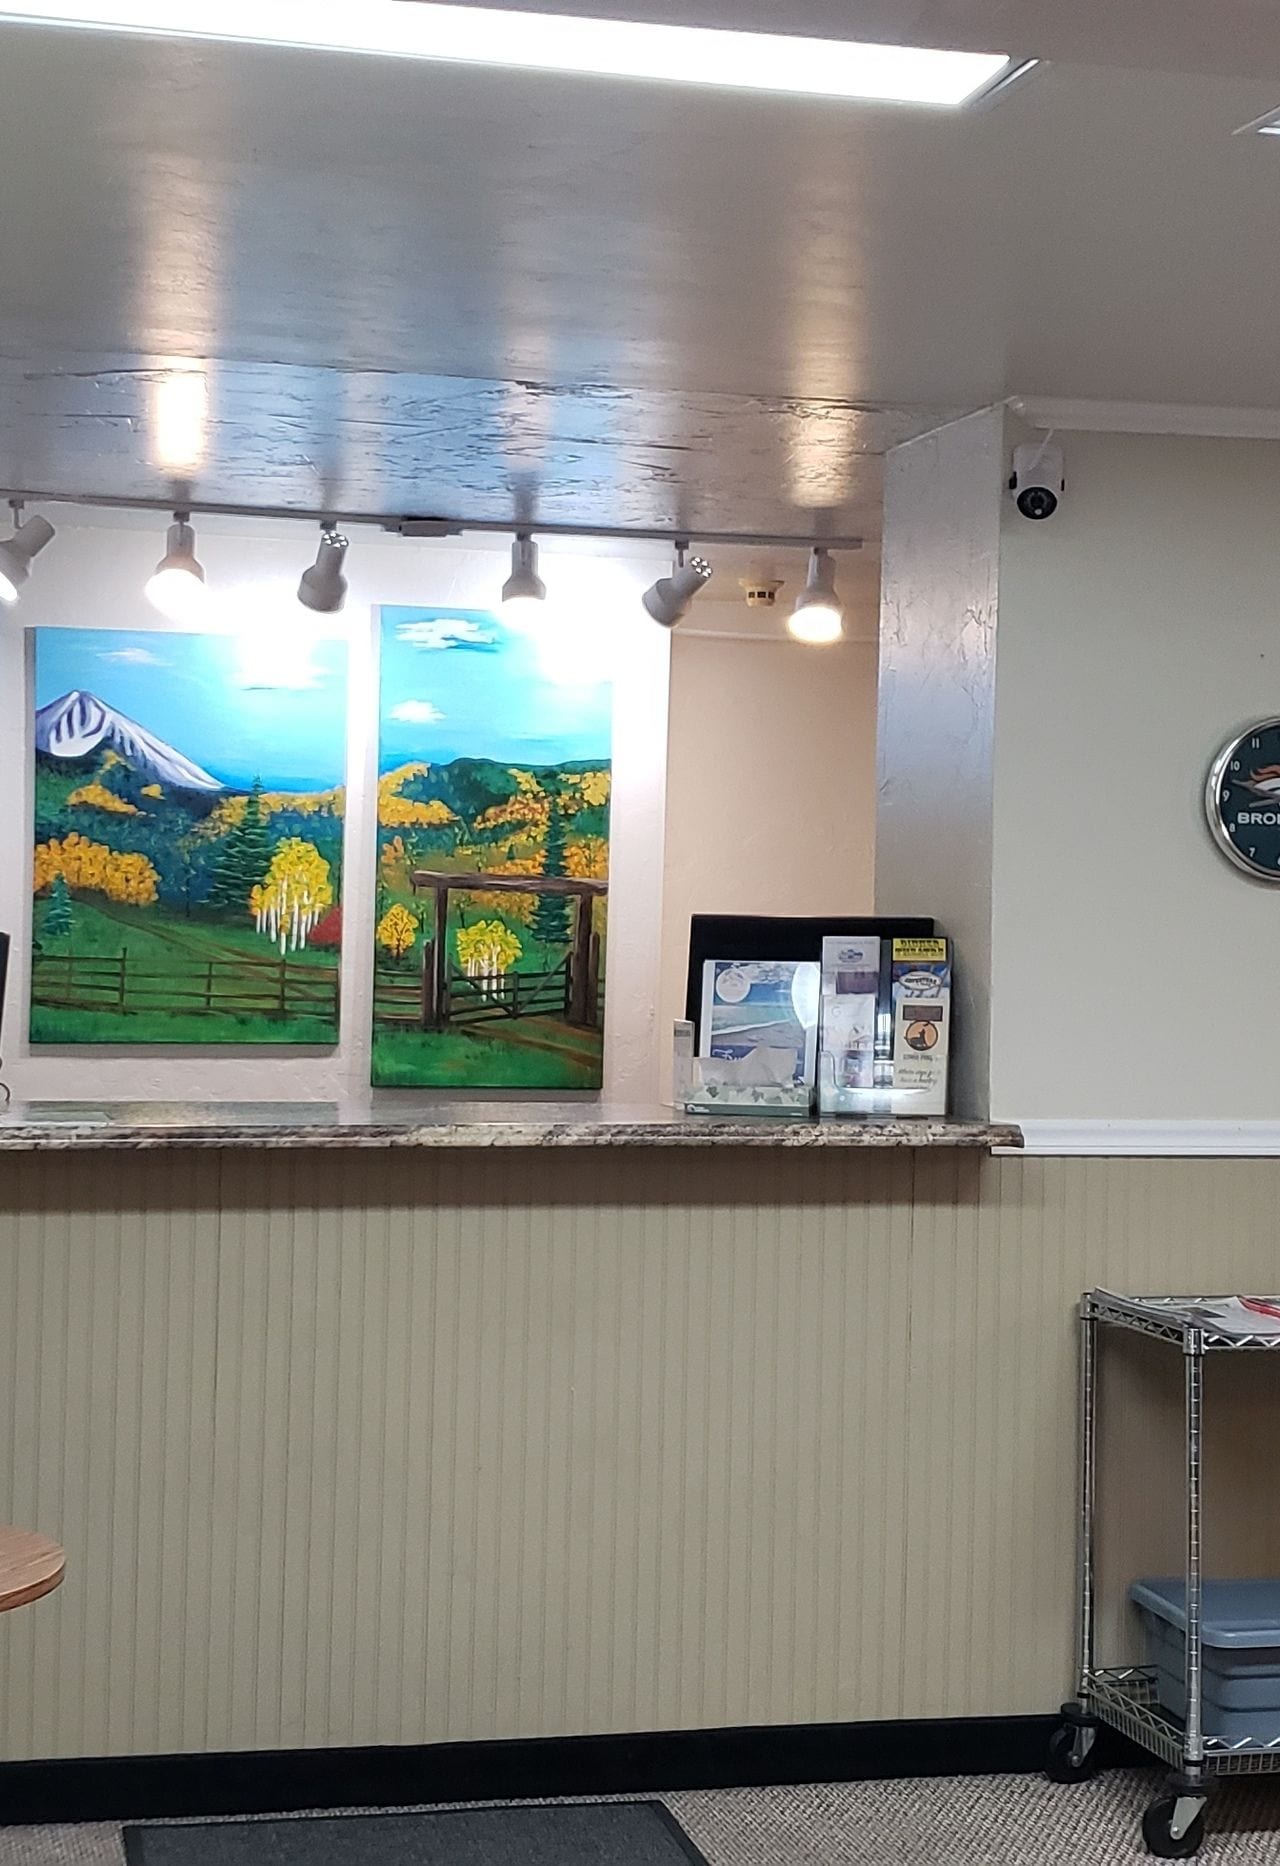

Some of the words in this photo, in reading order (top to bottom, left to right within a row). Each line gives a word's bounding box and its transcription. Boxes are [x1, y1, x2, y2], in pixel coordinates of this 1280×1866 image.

[1251, 738, 1260, 749] 11
[1230, 760, 1240, 771] 10
[1223, 791, 1230, 802] 9
[1229, 823, 1236, 833] 8
[1249, 848, 1256, 858] 7
